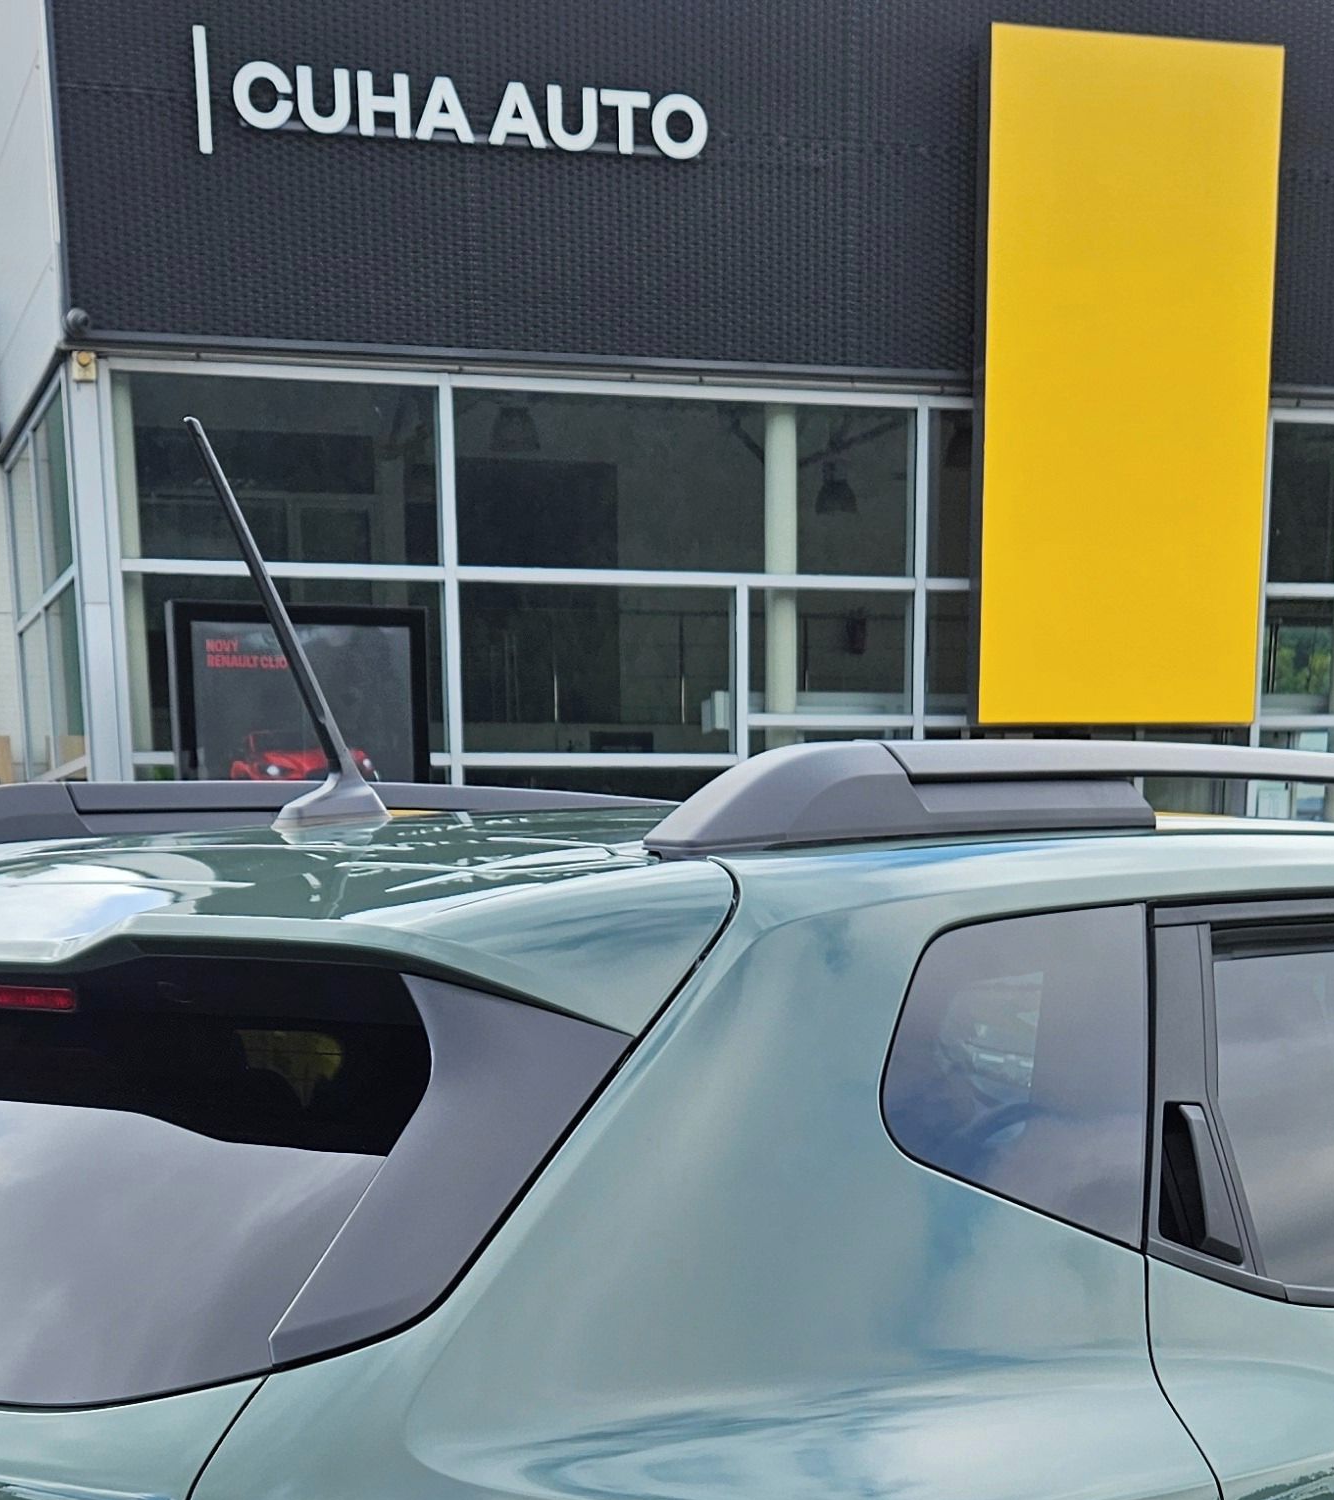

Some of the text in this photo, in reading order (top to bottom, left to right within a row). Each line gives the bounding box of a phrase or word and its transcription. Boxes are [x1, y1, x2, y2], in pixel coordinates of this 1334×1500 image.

[232, 60, 709, 160] CUHA AUTO
[206, 655, 259, 668] RENAULT
